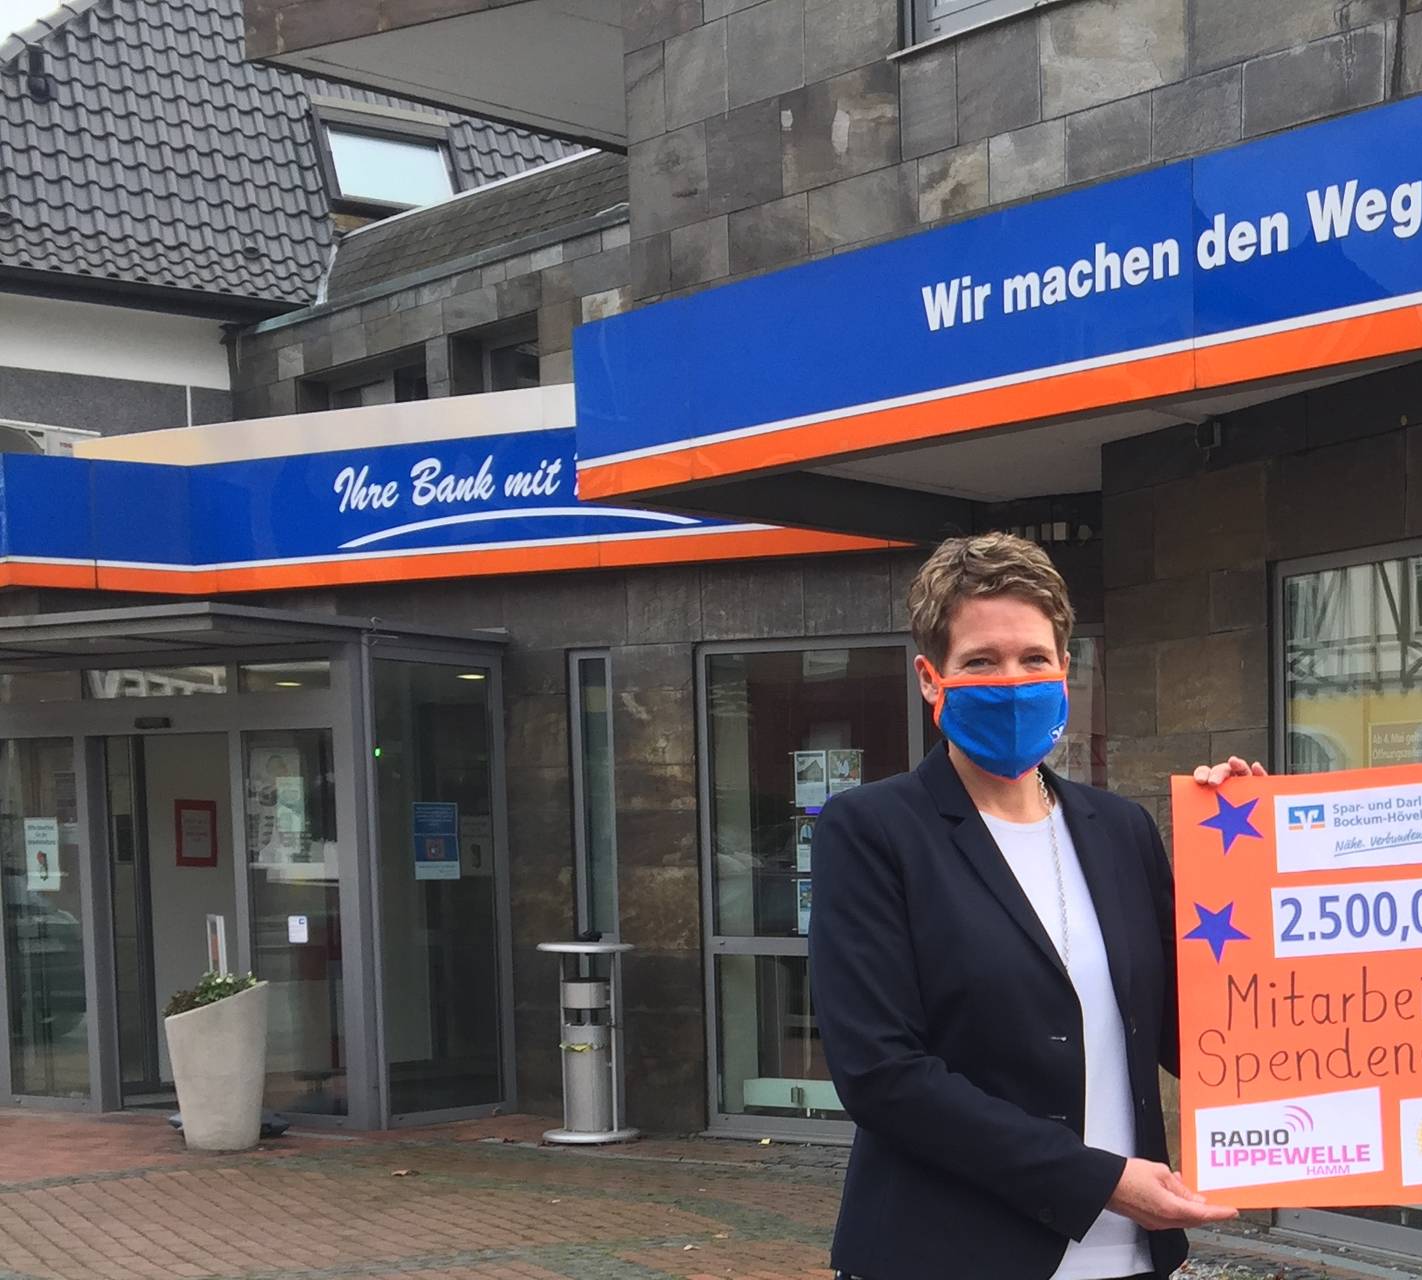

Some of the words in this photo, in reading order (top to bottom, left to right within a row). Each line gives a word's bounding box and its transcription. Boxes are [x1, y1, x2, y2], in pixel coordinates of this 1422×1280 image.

[921, 276, 991, 332] Wir
[1002, 238, 1179, 315] machen
[1196, 211, 1290, 270] den
[333, 465, 399, 512] Ihre
[410, 454, 496, 506] Bank
[504, 458, 562, 497] mit
[1332, 802, 1365, 815] Spar-
[1368, 799, 1392, 811] und
[1211, 1129, 1290, 1148] RADIO
[1211, 1143, 1371, 1168] LIPPEWELLE
[1306, 1164, 1351, 1176] HAMM
